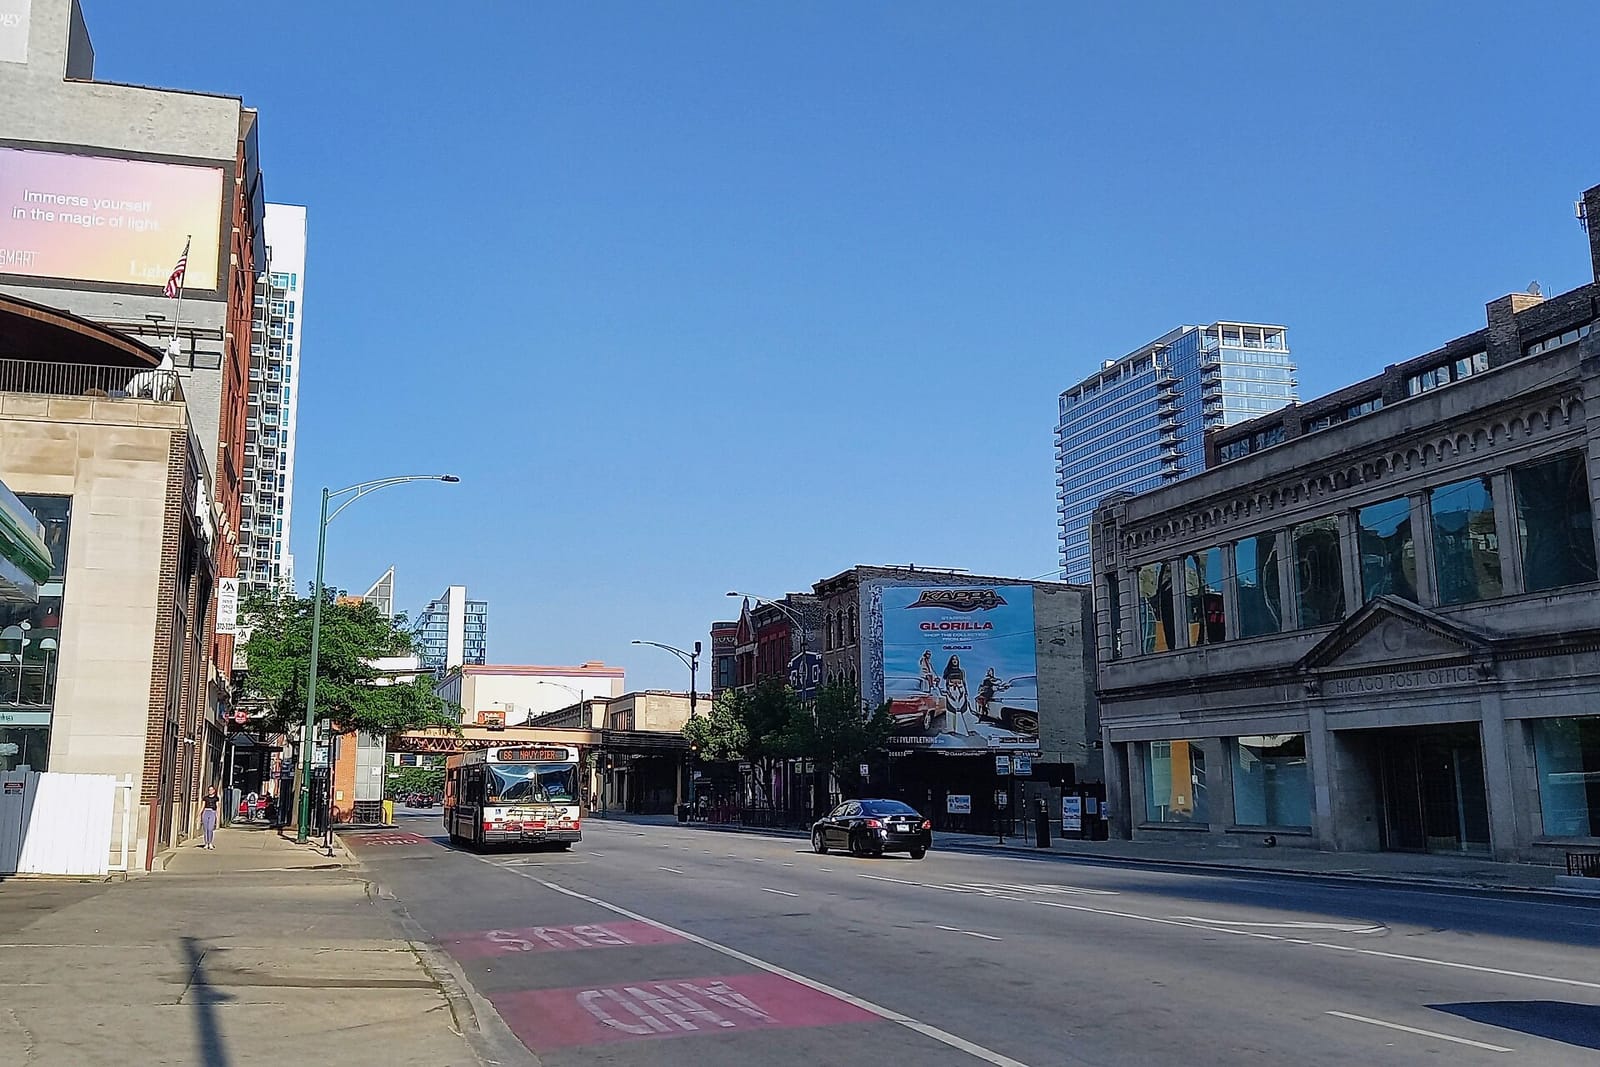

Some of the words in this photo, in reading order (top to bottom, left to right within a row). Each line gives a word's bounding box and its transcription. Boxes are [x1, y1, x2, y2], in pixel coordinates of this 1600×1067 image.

[23, 189, 89, 207] Immerse
[93, 198, 152, 212] yourself
[12, 206, 26, 219] in
[31, 207, 55, 221] the
[58, 212, 105, 228] magic
[109, 216, 124, 228] of
[921, 589, 997, 601] KAPPA
[920, 622, 993, 630] GLORILLA
[1329, 676, 1384, 695] CHICAGO
[1389, 672, 1423, 689] POST
[1428, 666, 1476, 685] OFFICE
[520, 750, 538, 760] NAVY
[540, 750, 555, 760] PIER
[486, 925, 634, 951] BUS
